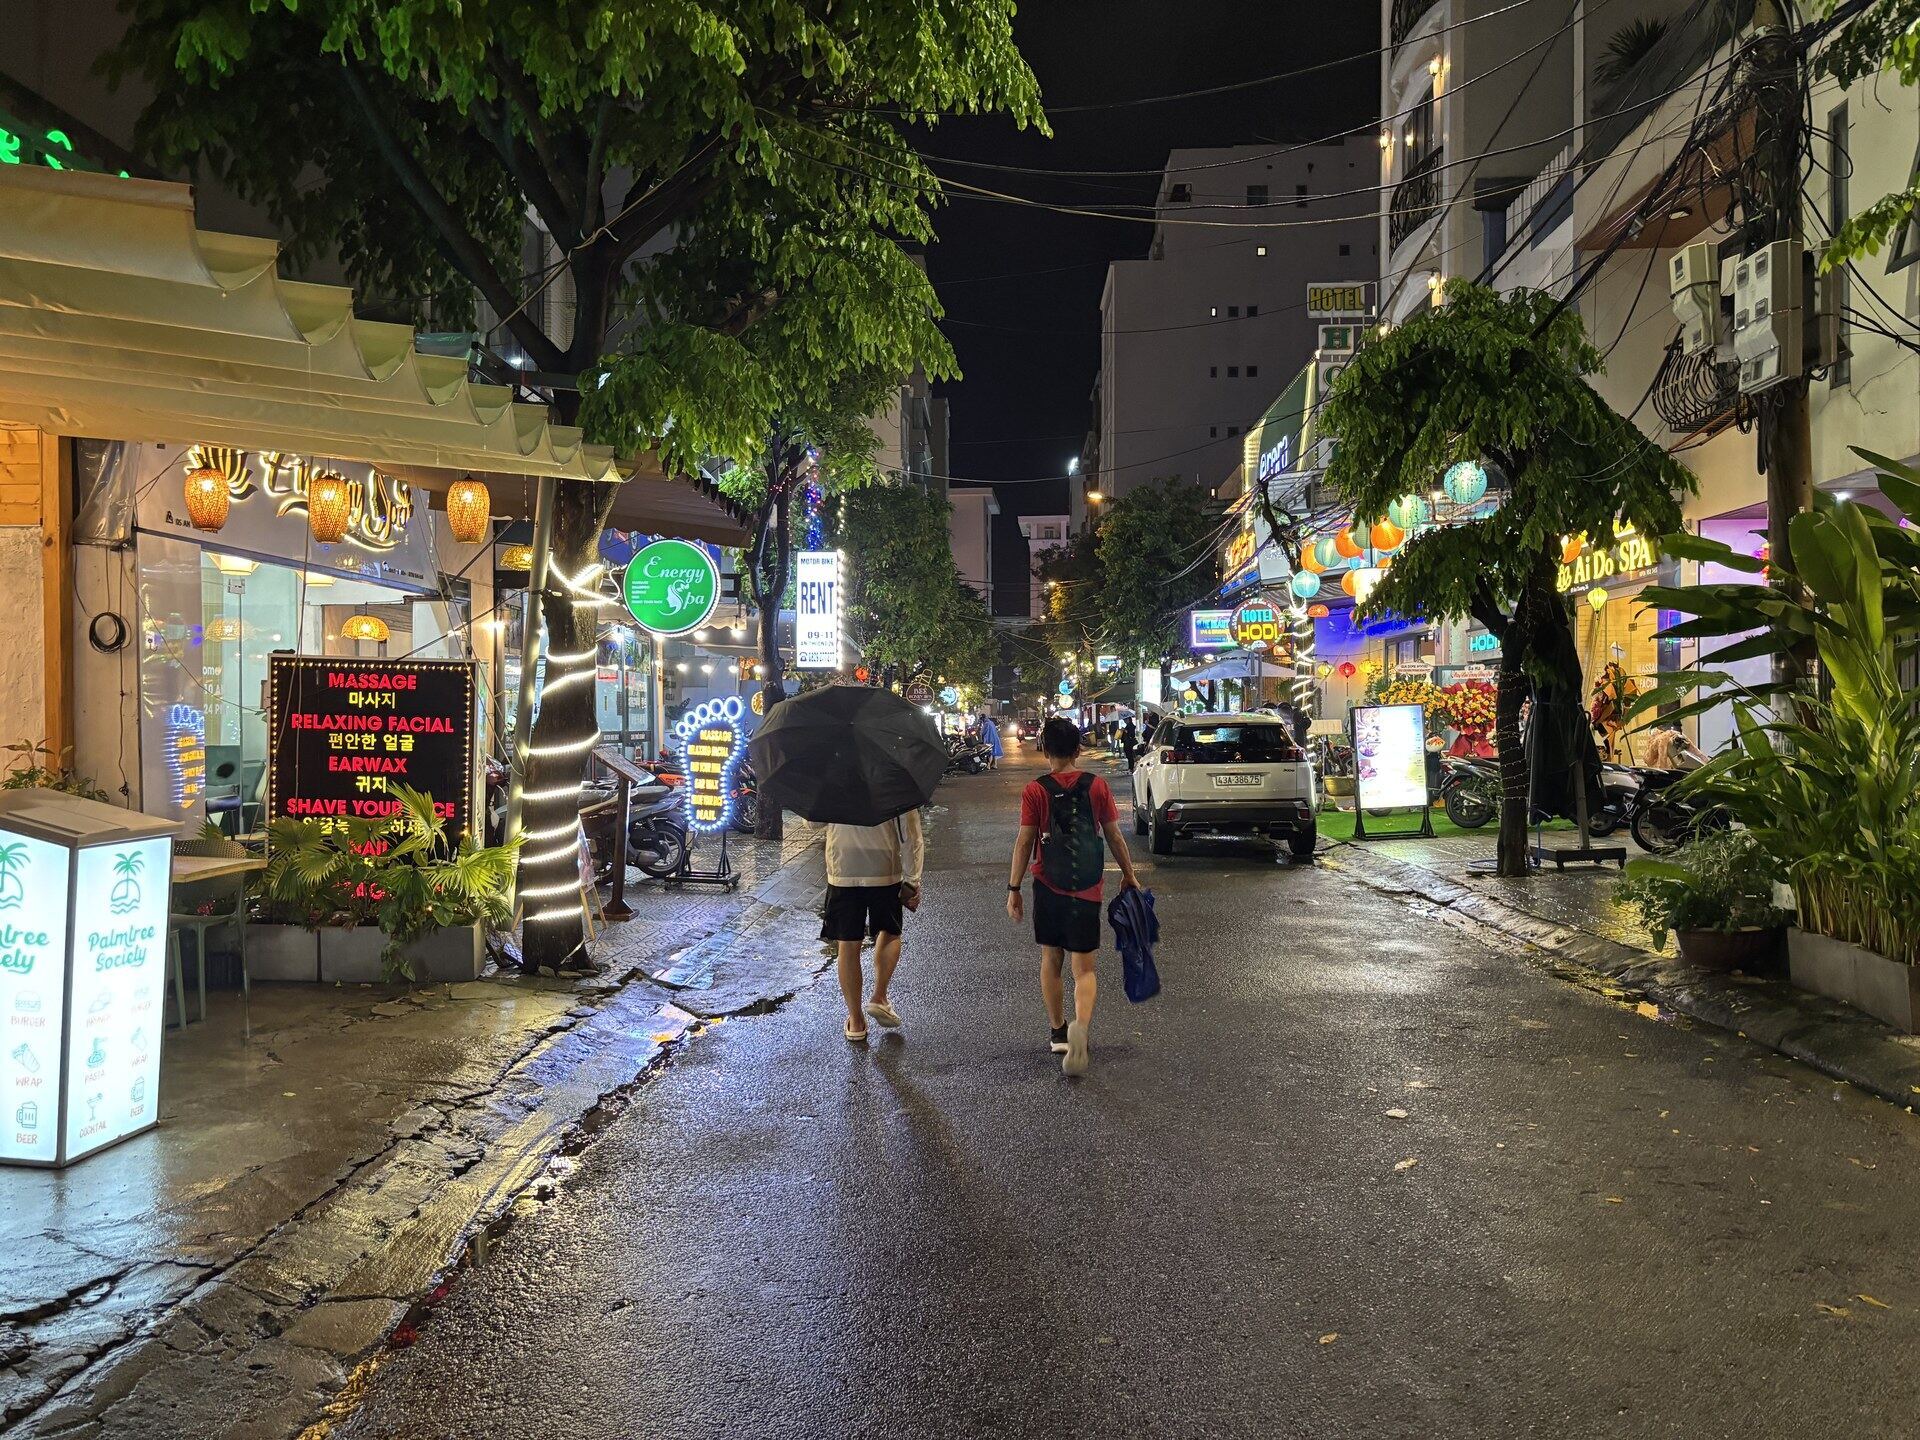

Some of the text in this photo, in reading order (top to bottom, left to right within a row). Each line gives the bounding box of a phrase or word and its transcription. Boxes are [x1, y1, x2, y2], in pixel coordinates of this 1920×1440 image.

[1309, 288, 1364, 311] HOTEL
[643, 555, 705, 583] Energy
[1574, 537, 1652, 584] Ai Do SPA
[801, 582, 834, 614] RENT
[1241, 609, 1275, 622] HOTEL
[807, 631, 834, 639] 09-11
[1238, 624, 1278, 640] HODI
[328, 673, 417, 690] MASSAGE
[348, 692, 396, 709] 마사지
[291, 713, 454, 733] RELAXING FACIAL
[328, 732, 415, 751] 편안한 얼굴
[328, 756, 407, 773] EARWAX
[355, 776, 387, 793] 귀지
[287, 798, 346, 815] SHAVE
[88, 925, 155, 951] Palmtree
[95, 945, 147, 972] Society
[10, 1015, 46, 1027] BURGER
[15, 1077, 43, 1087] WRAP
[130, 1105, 145, 1118] BEER
[16, 1132, 38, 1145] BEER
